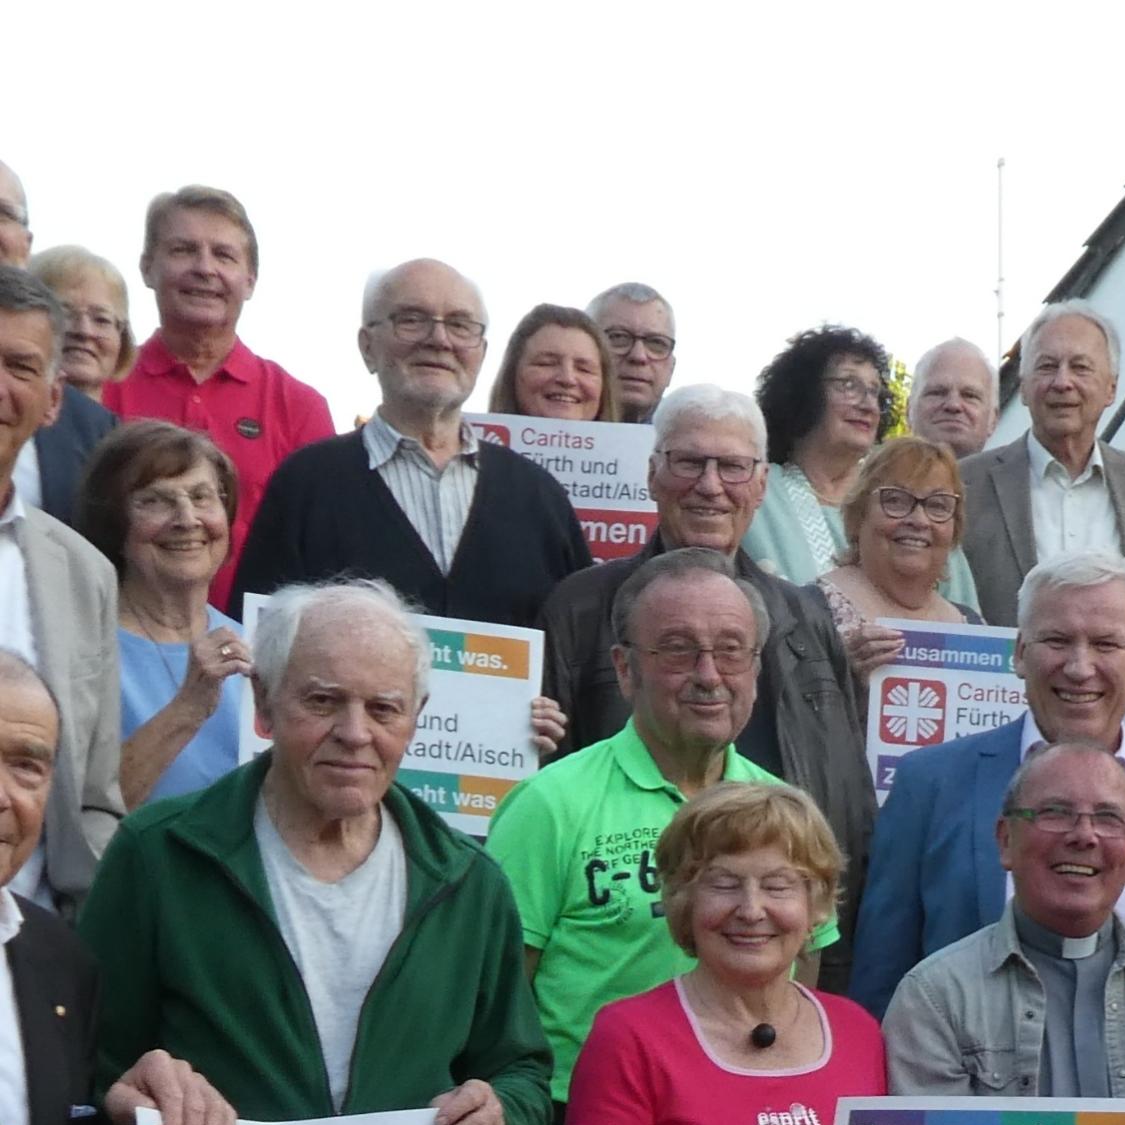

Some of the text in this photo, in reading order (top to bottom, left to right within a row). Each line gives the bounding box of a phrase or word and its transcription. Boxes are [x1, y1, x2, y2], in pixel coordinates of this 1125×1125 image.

[521, 428, 595, 450] Caritas
[581, 458, 618, 475] und
[457, 649, 508, 670] was.
[595, 827, 660, 846] EXPLORE
